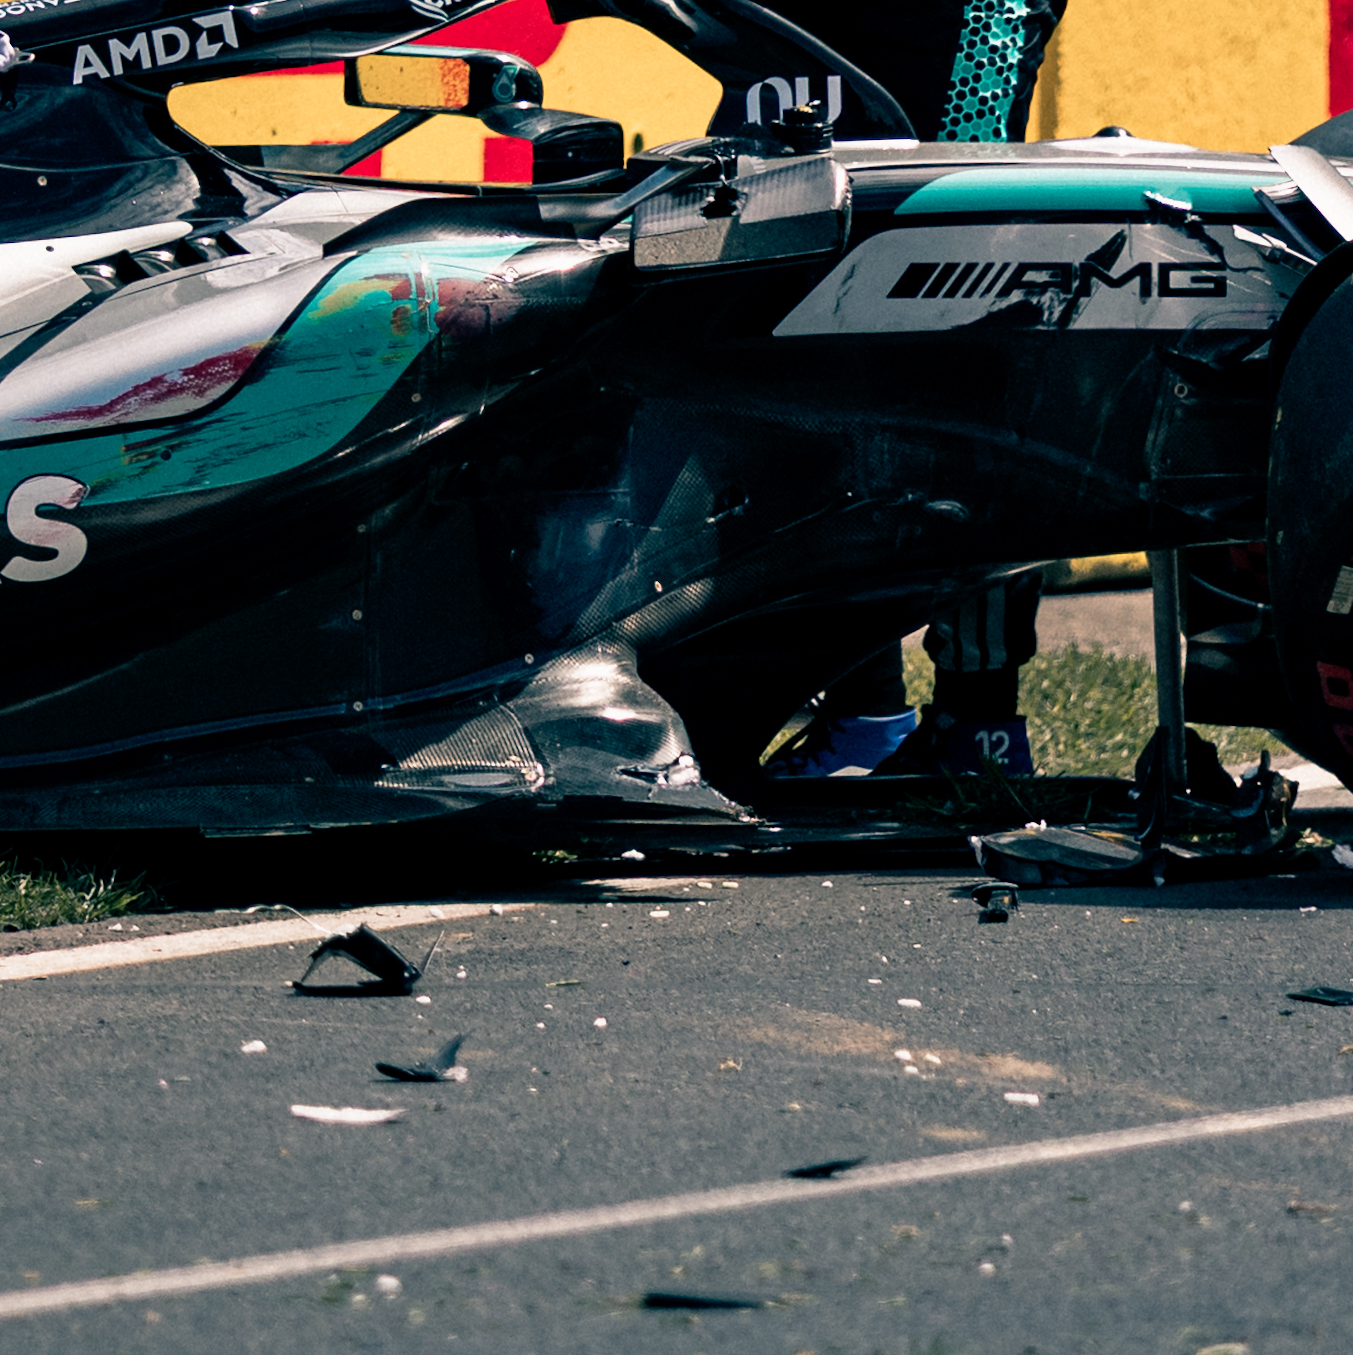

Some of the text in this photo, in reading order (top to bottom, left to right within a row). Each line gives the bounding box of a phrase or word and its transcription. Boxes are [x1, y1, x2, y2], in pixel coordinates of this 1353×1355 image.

[72, 25, 191, 86] AMD
[994, 261, 1228, 299] AMG
[974, 729, 1010, 764] 12
